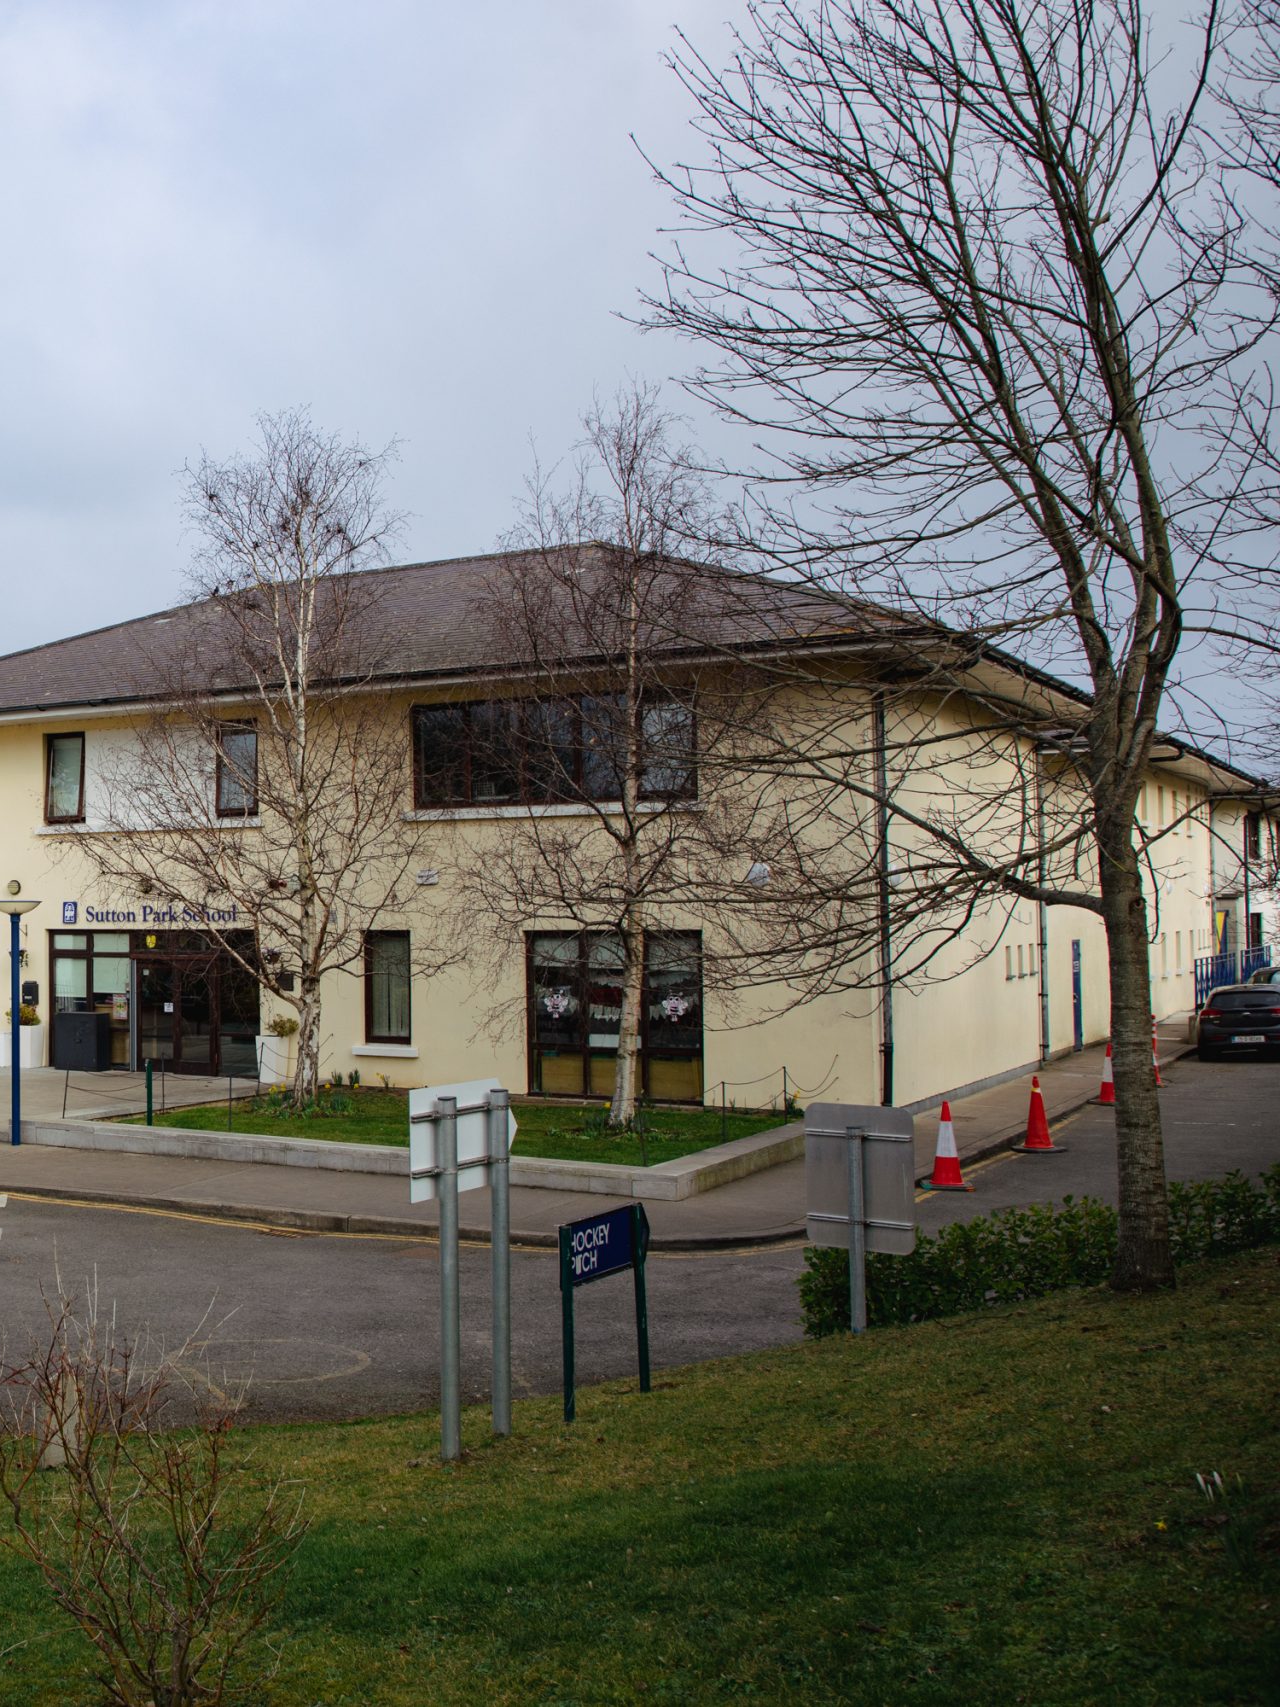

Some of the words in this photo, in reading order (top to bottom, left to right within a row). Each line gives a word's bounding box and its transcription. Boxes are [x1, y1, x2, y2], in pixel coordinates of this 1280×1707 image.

[86, 906, 136, 922] Sutton
[142, 906, 178, 922] Park
[182, 904, 237, 922] School
